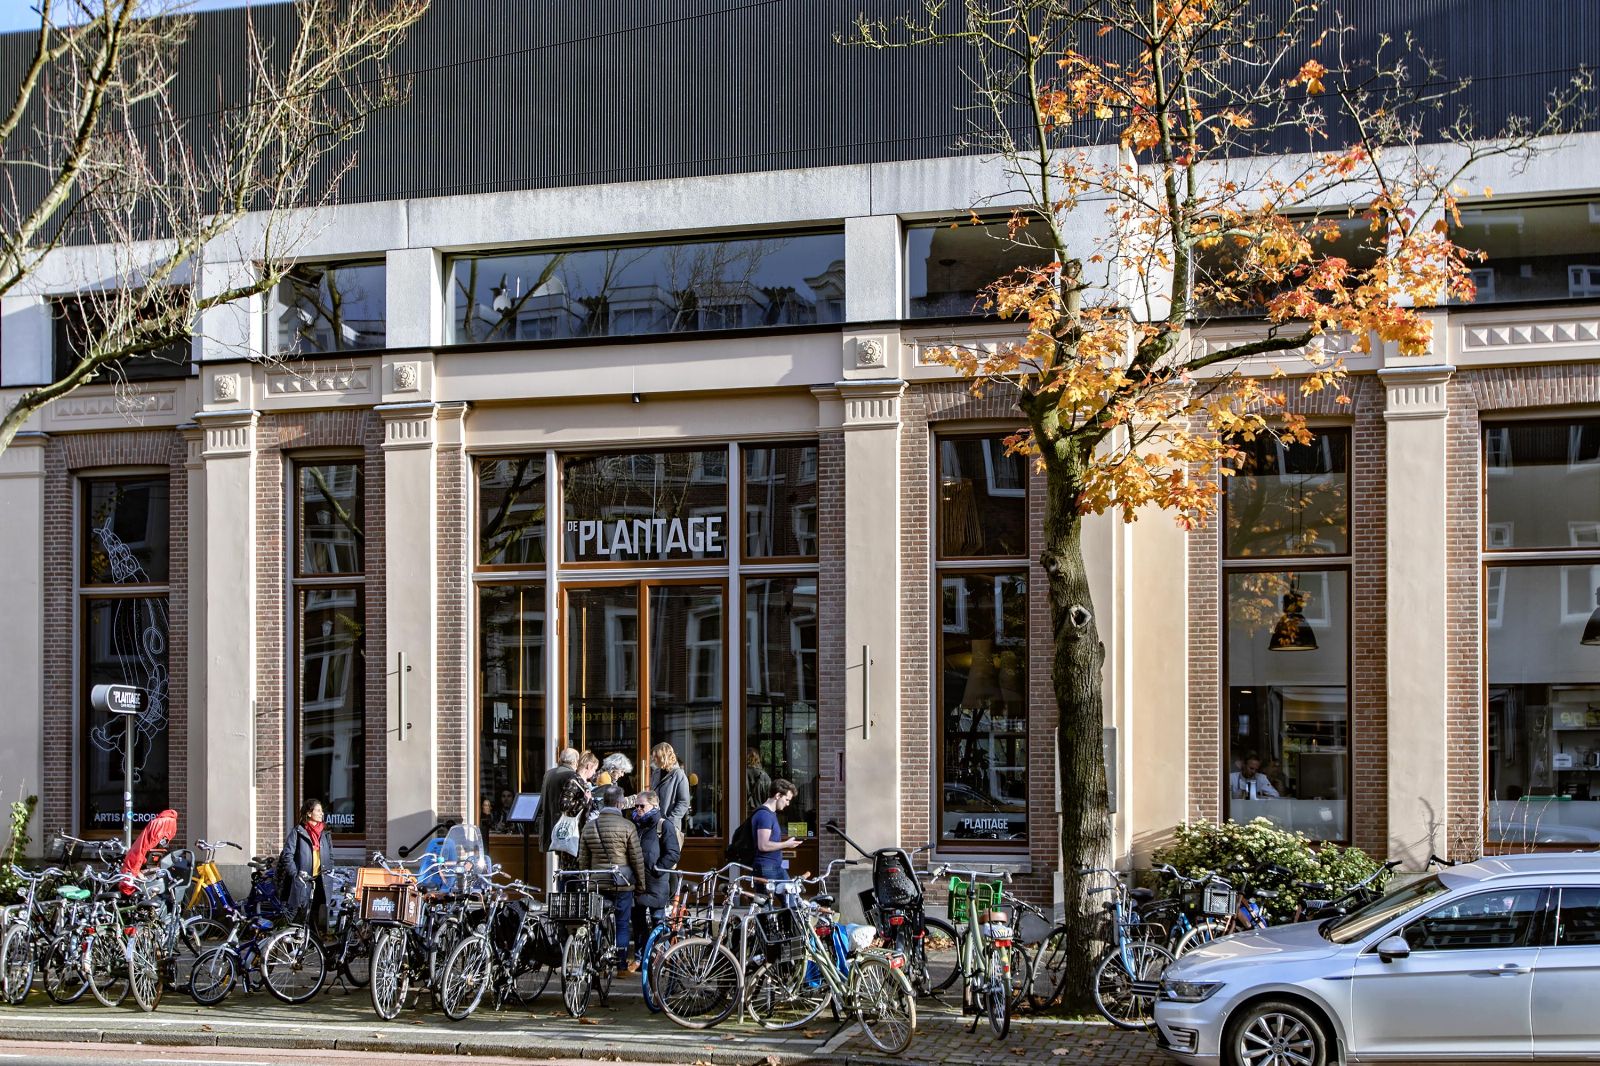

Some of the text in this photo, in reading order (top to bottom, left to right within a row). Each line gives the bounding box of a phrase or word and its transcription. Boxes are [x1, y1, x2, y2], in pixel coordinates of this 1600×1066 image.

[567, 516, 722, 555] DE PLANTAGE
[94, 812, 120, 822] ARTIS
[964, 818, 1009, 830] PLANTAGE
